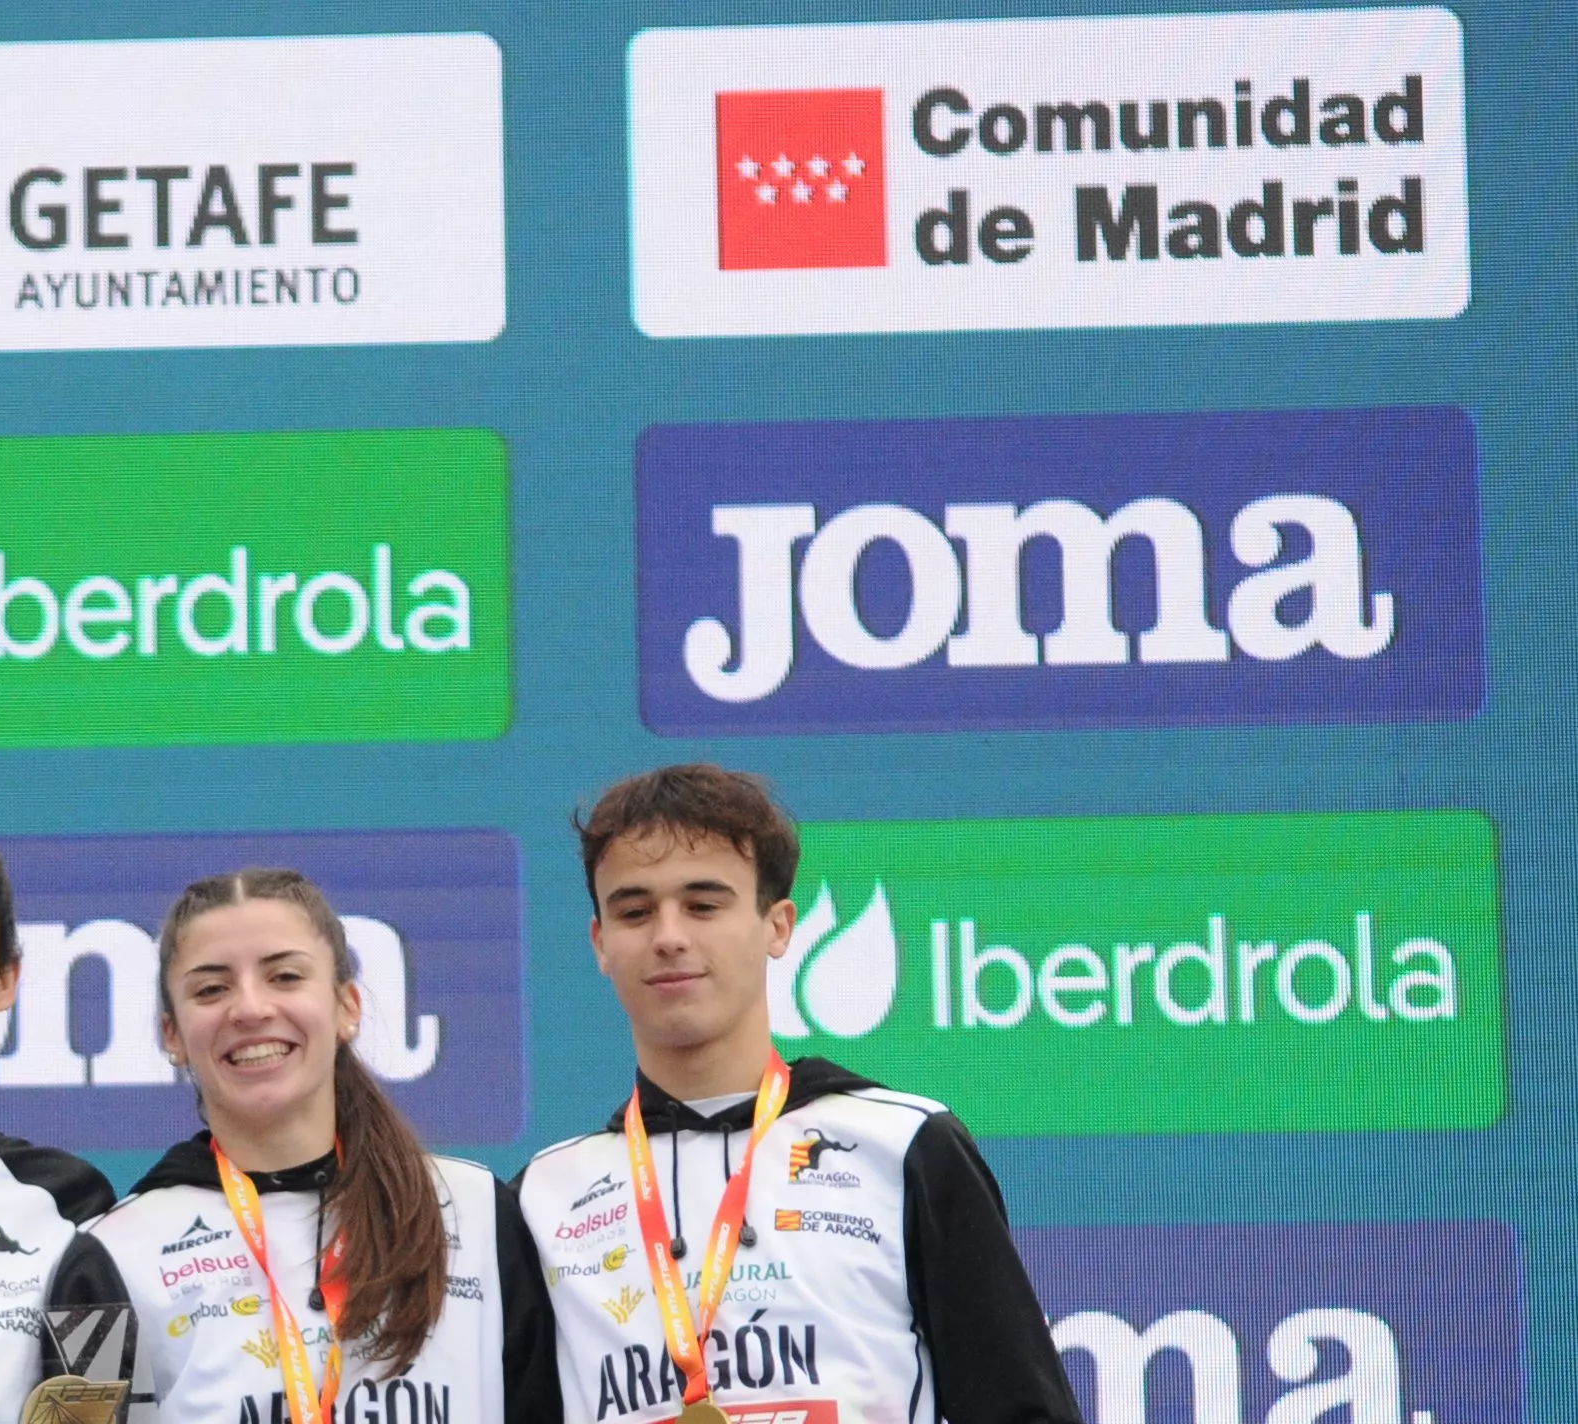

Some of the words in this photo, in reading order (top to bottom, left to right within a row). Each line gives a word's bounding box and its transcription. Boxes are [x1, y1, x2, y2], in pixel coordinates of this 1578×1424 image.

[911, 74, 1423, 157] Comunidad
[9, 161, 359, 251] GETAFE
[914, 190, 1035, 266] de
[1076, 177, 1423, 262] Madrid
[14, 267, 361, 310] AYUNTAMIENTO
[931, 911, 1458, 1029] Iberdrola
[555, 1201, 628, 1240] belsue
[802, 1211, 874, 1230] GOBIERNO
[802, 1221, 820, 1232] DE
[161, 1230, 233, 1255] MERCURY
[159, 1253, 249, 1288] belsue
[728, 1261, 793, 1282] URAL
